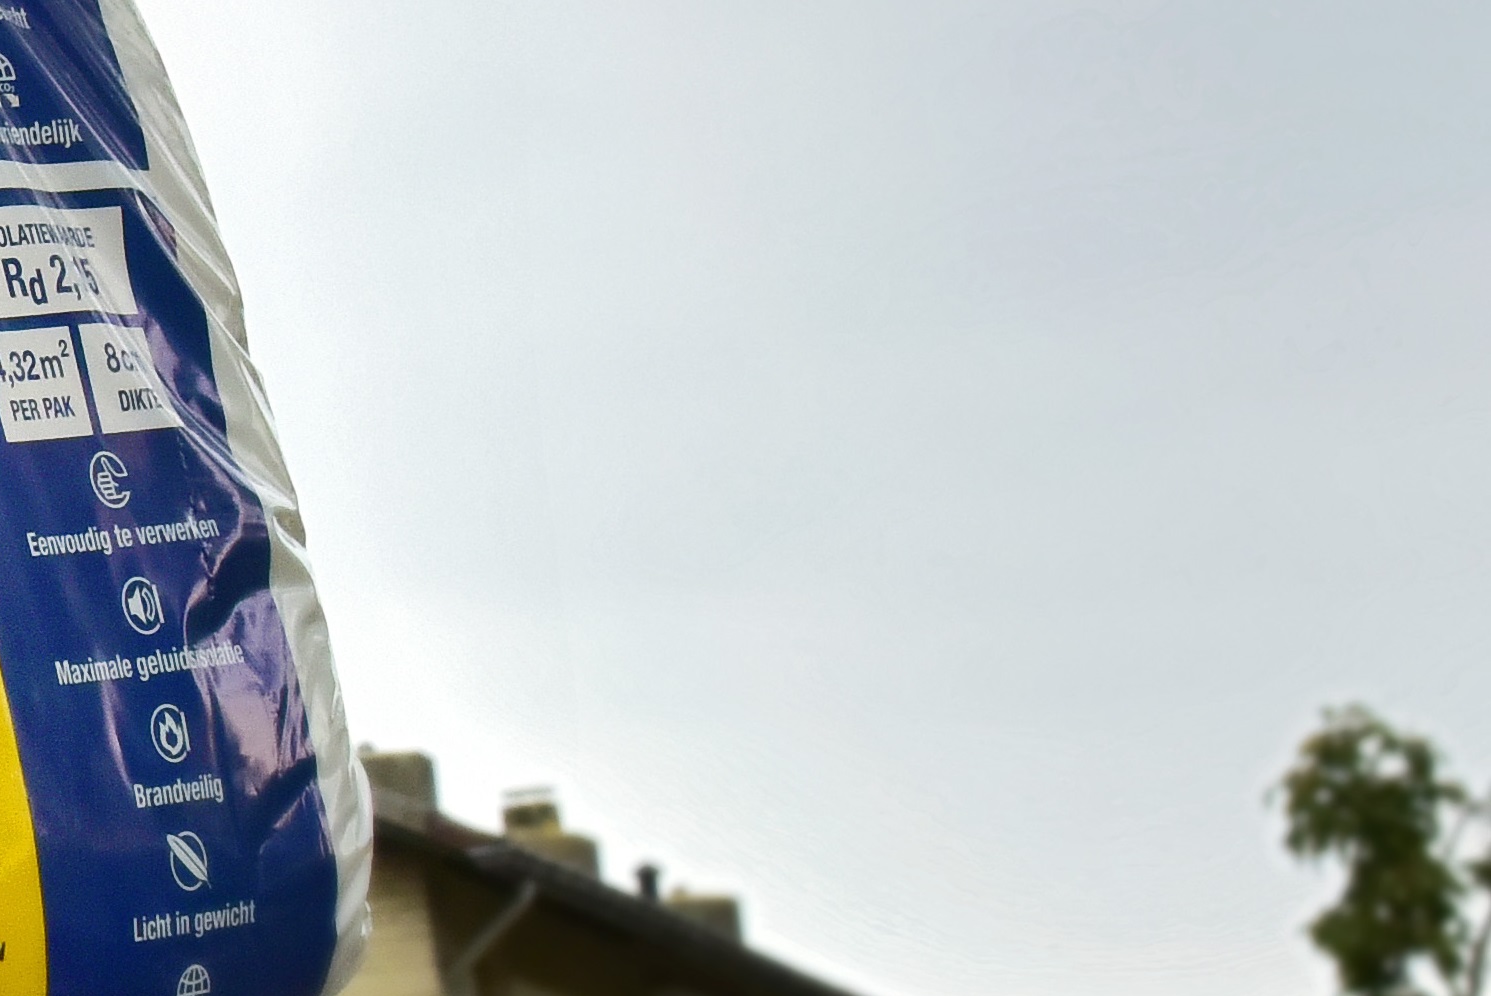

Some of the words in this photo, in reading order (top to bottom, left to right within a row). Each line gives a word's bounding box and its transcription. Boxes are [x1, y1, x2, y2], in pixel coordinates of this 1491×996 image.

[1, 257, 49, 306] Rd
[9, 398, 41, 422] PER
[43, 395, 76, 420] PAK
[27, 525, 112, 557] Eenvoudig
[114, 524, 133, 548] te
[135, 518, 221, 546] verwerken
[54, 653, 134, 687] Maximale
[136, 639, 245, 682] geluidsisolatie
[133, 774, 224, 809] Brandveilig
[133, 912, 172, 943] Licht
[175, 910, 191, 937] in
[193, 899, 256, 938] gewicht
